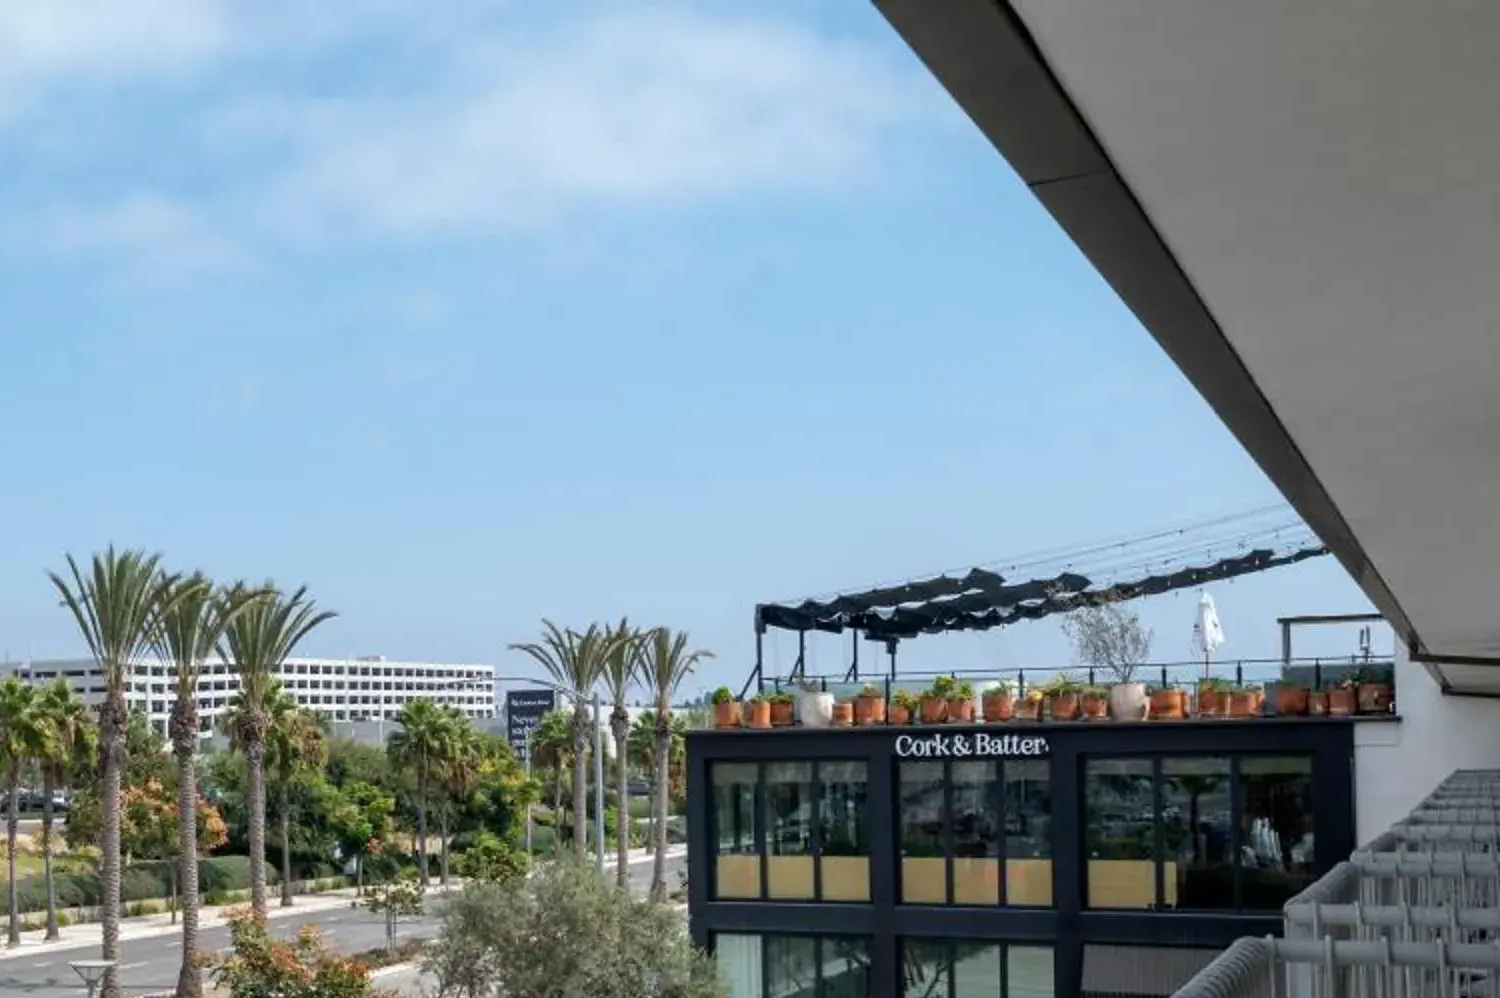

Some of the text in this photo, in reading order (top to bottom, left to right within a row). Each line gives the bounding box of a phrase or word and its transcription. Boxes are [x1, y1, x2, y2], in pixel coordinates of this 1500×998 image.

[895, 733, 1046, 757] Cork & Batter
